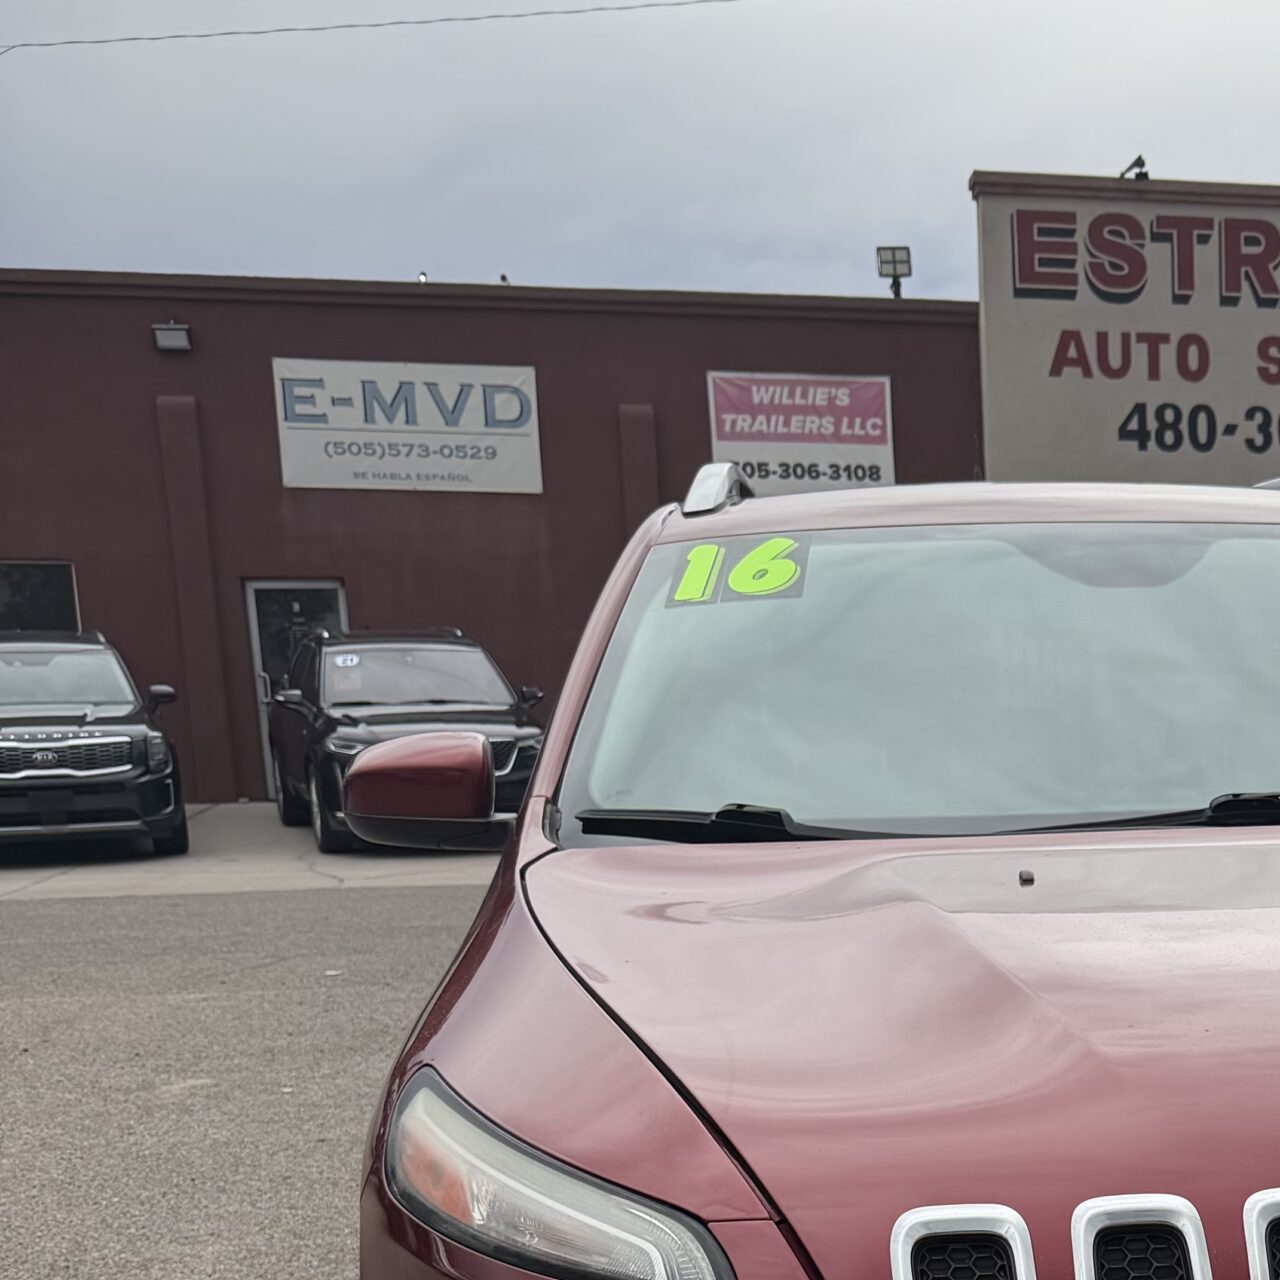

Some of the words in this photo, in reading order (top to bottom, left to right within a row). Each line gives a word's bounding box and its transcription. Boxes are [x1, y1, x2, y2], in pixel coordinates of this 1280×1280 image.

[1048, 330, 1211, 383] AUTO
[280, 377, 532, 429] E-MVD
[751, 385, 851, 406] WILLIE'S
[722, 414, 835, 435] TRAILERS
[841, 417, 883, 437] LLC
[323, 440, 498, 461] (505)573-0529
[372, 471, 413, 481] HABLA
[731, 461, 882, 482] 05-306-3108
[674, 537, 800, 602] 16
